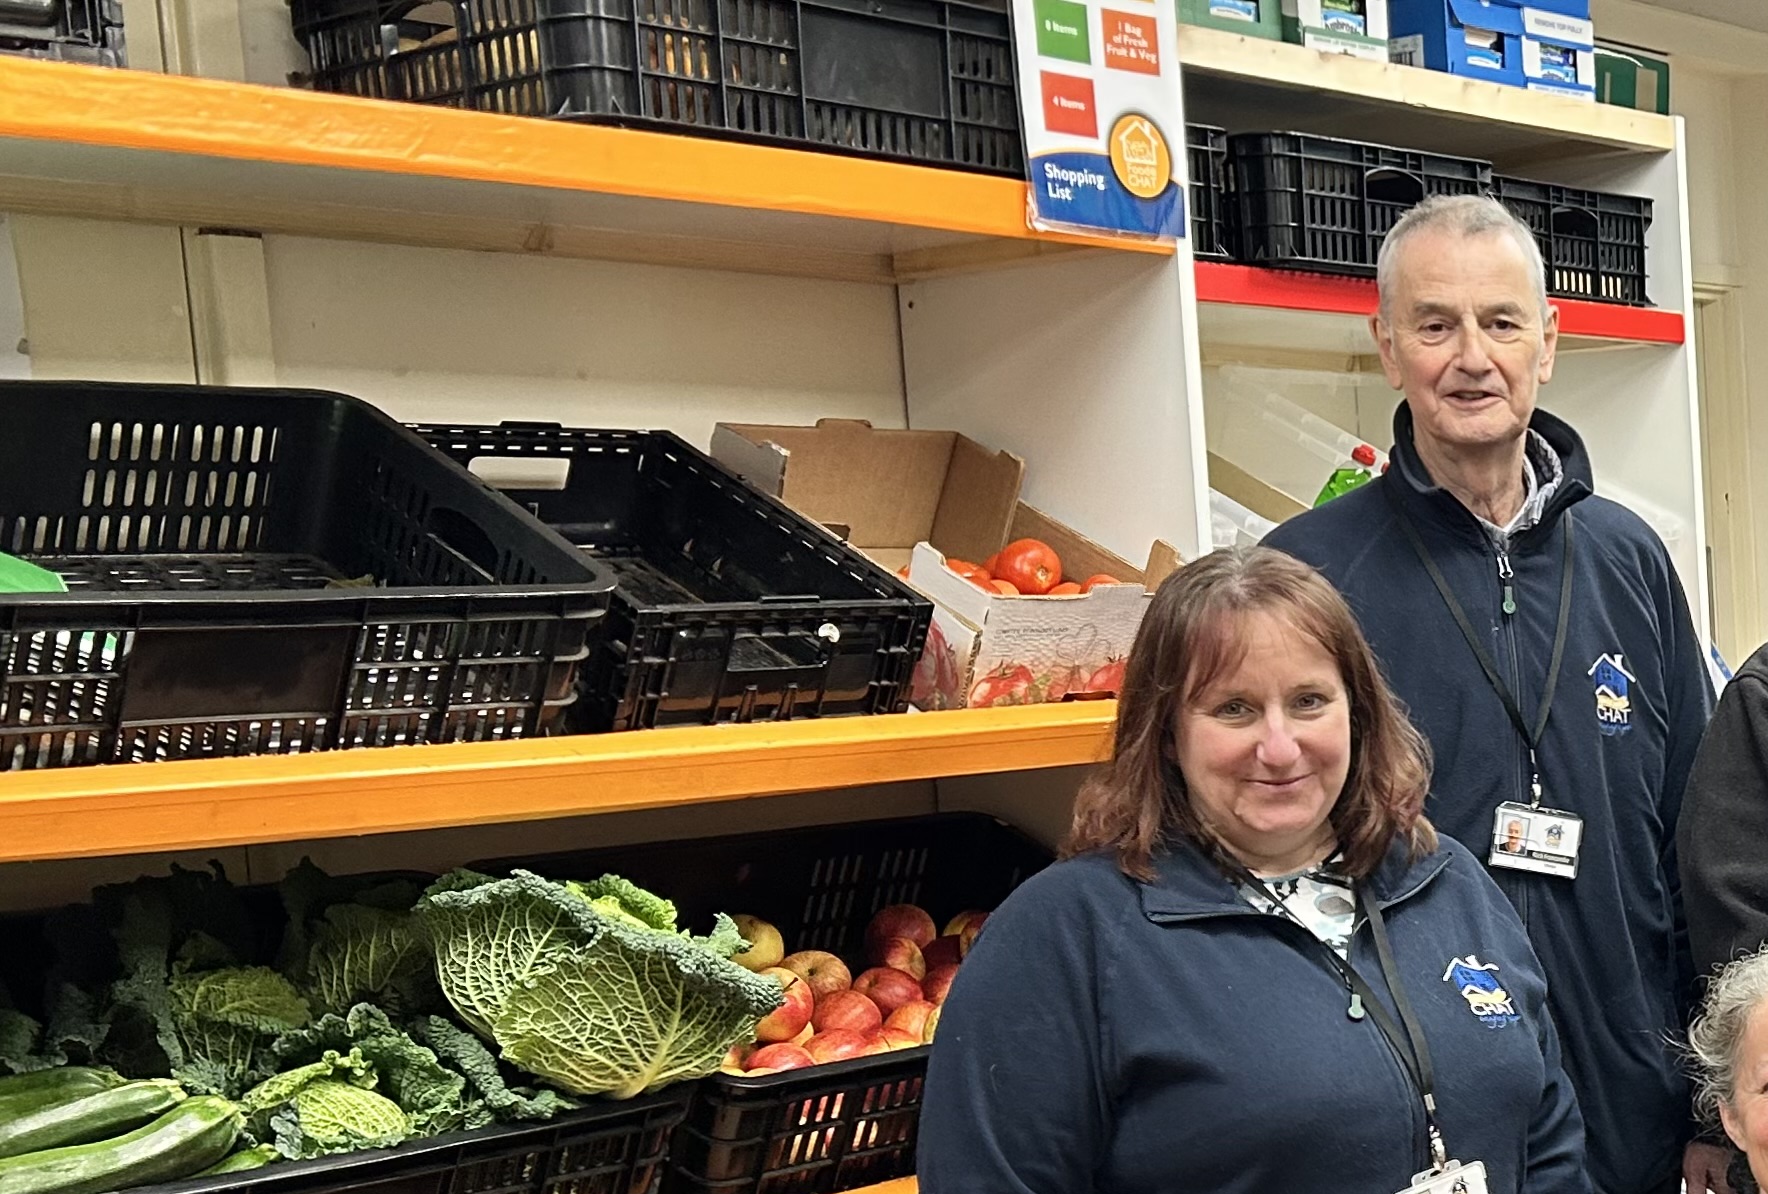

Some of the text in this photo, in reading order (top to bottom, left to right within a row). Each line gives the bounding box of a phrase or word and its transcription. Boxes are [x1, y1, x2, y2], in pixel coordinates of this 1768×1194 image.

[1123, 35, 1148, 48] Fresh
[1106, 43, 1128, 57] Fruit
[1138, 49, 1157, 64] Veg
[1044, 162, 1105, 191] Shopping
[1128, 174, 1156, 189] CHAT
[1048, 182, 1072, 201] List
[1596, 704, 1632, 723] CHAT
[1470, 998, 1515, 1015] CHAT
